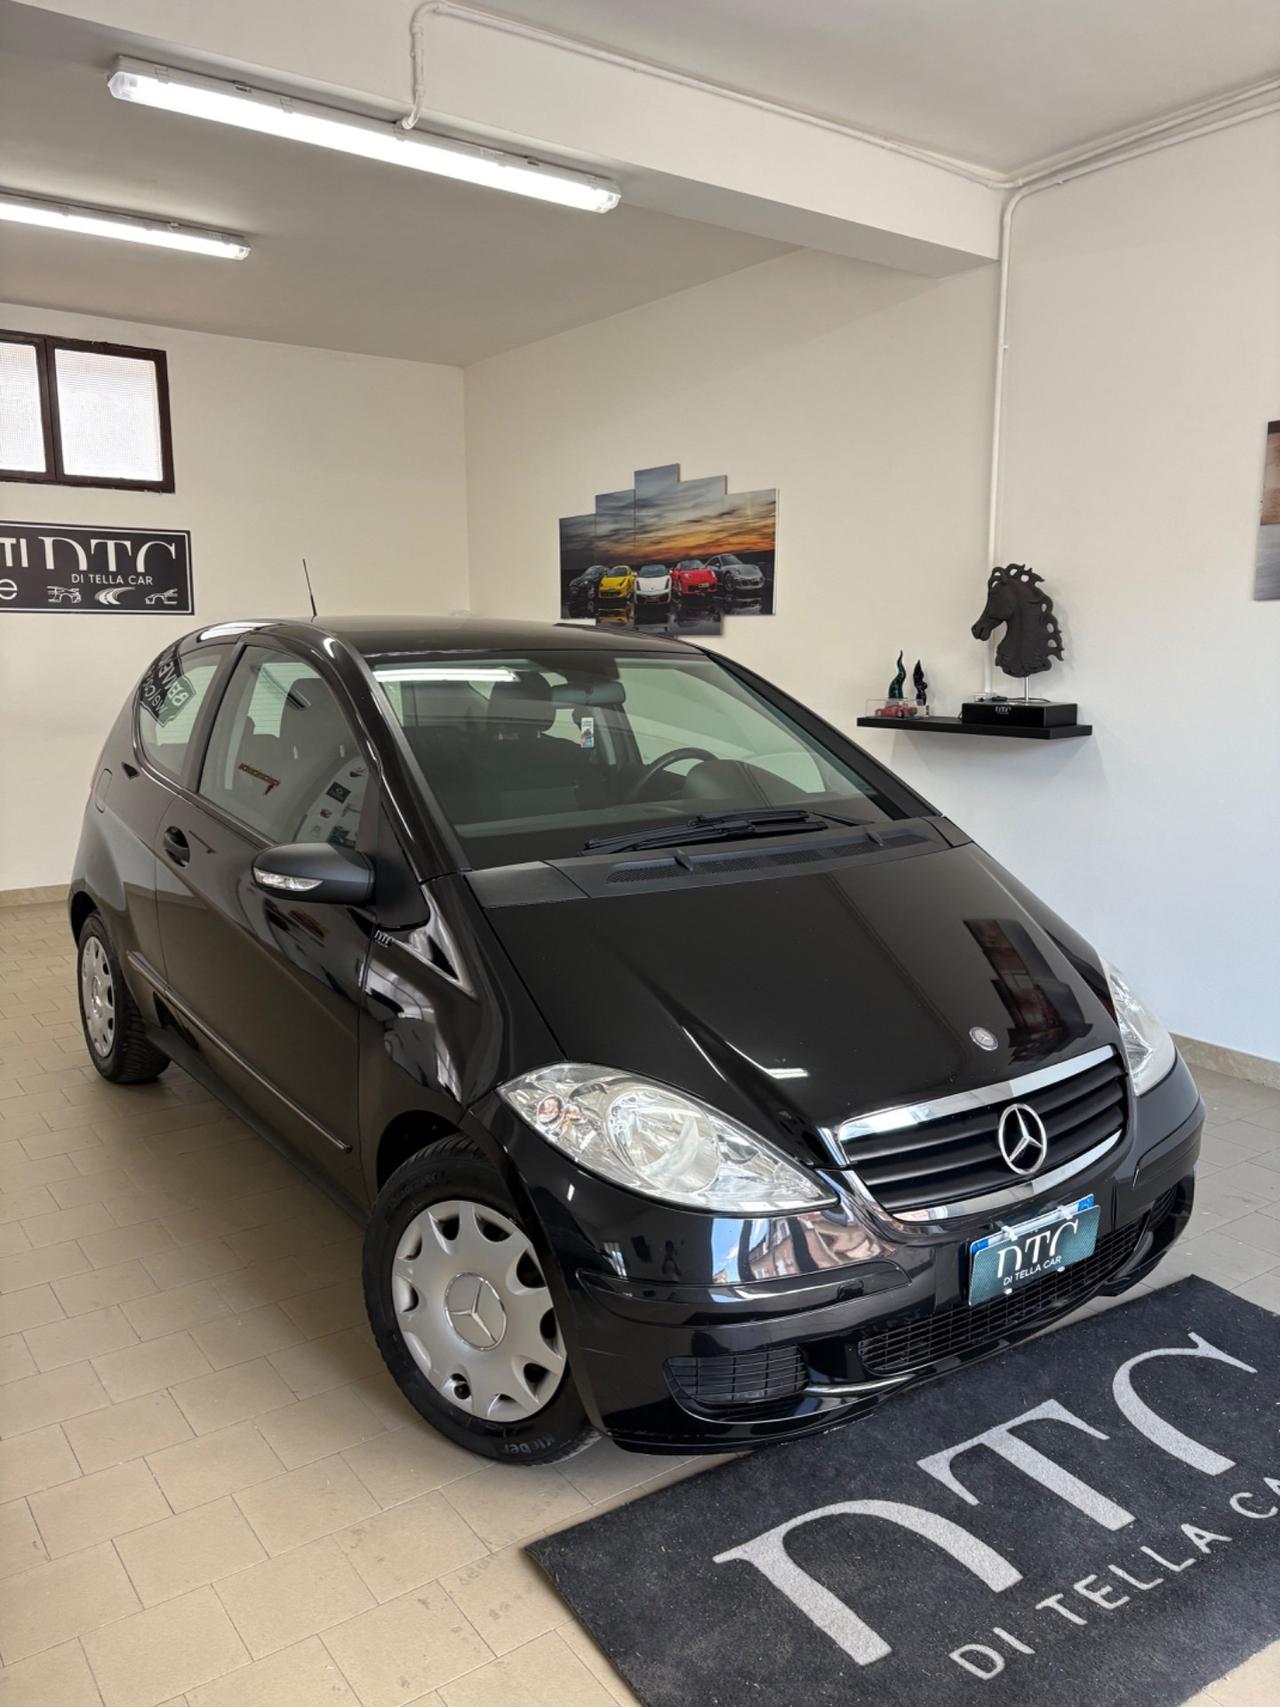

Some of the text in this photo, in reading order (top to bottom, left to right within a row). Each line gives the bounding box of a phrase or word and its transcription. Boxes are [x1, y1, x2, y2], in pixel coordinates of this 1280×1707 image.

[71, 573, 153, 586] DI TELLA CAR
[1003, 1255, 1062, 1286] DI TELLA CAR
[949, 1627, 1035, 1681] DI
[1035, 1522, 1233, 1627] TELLA
